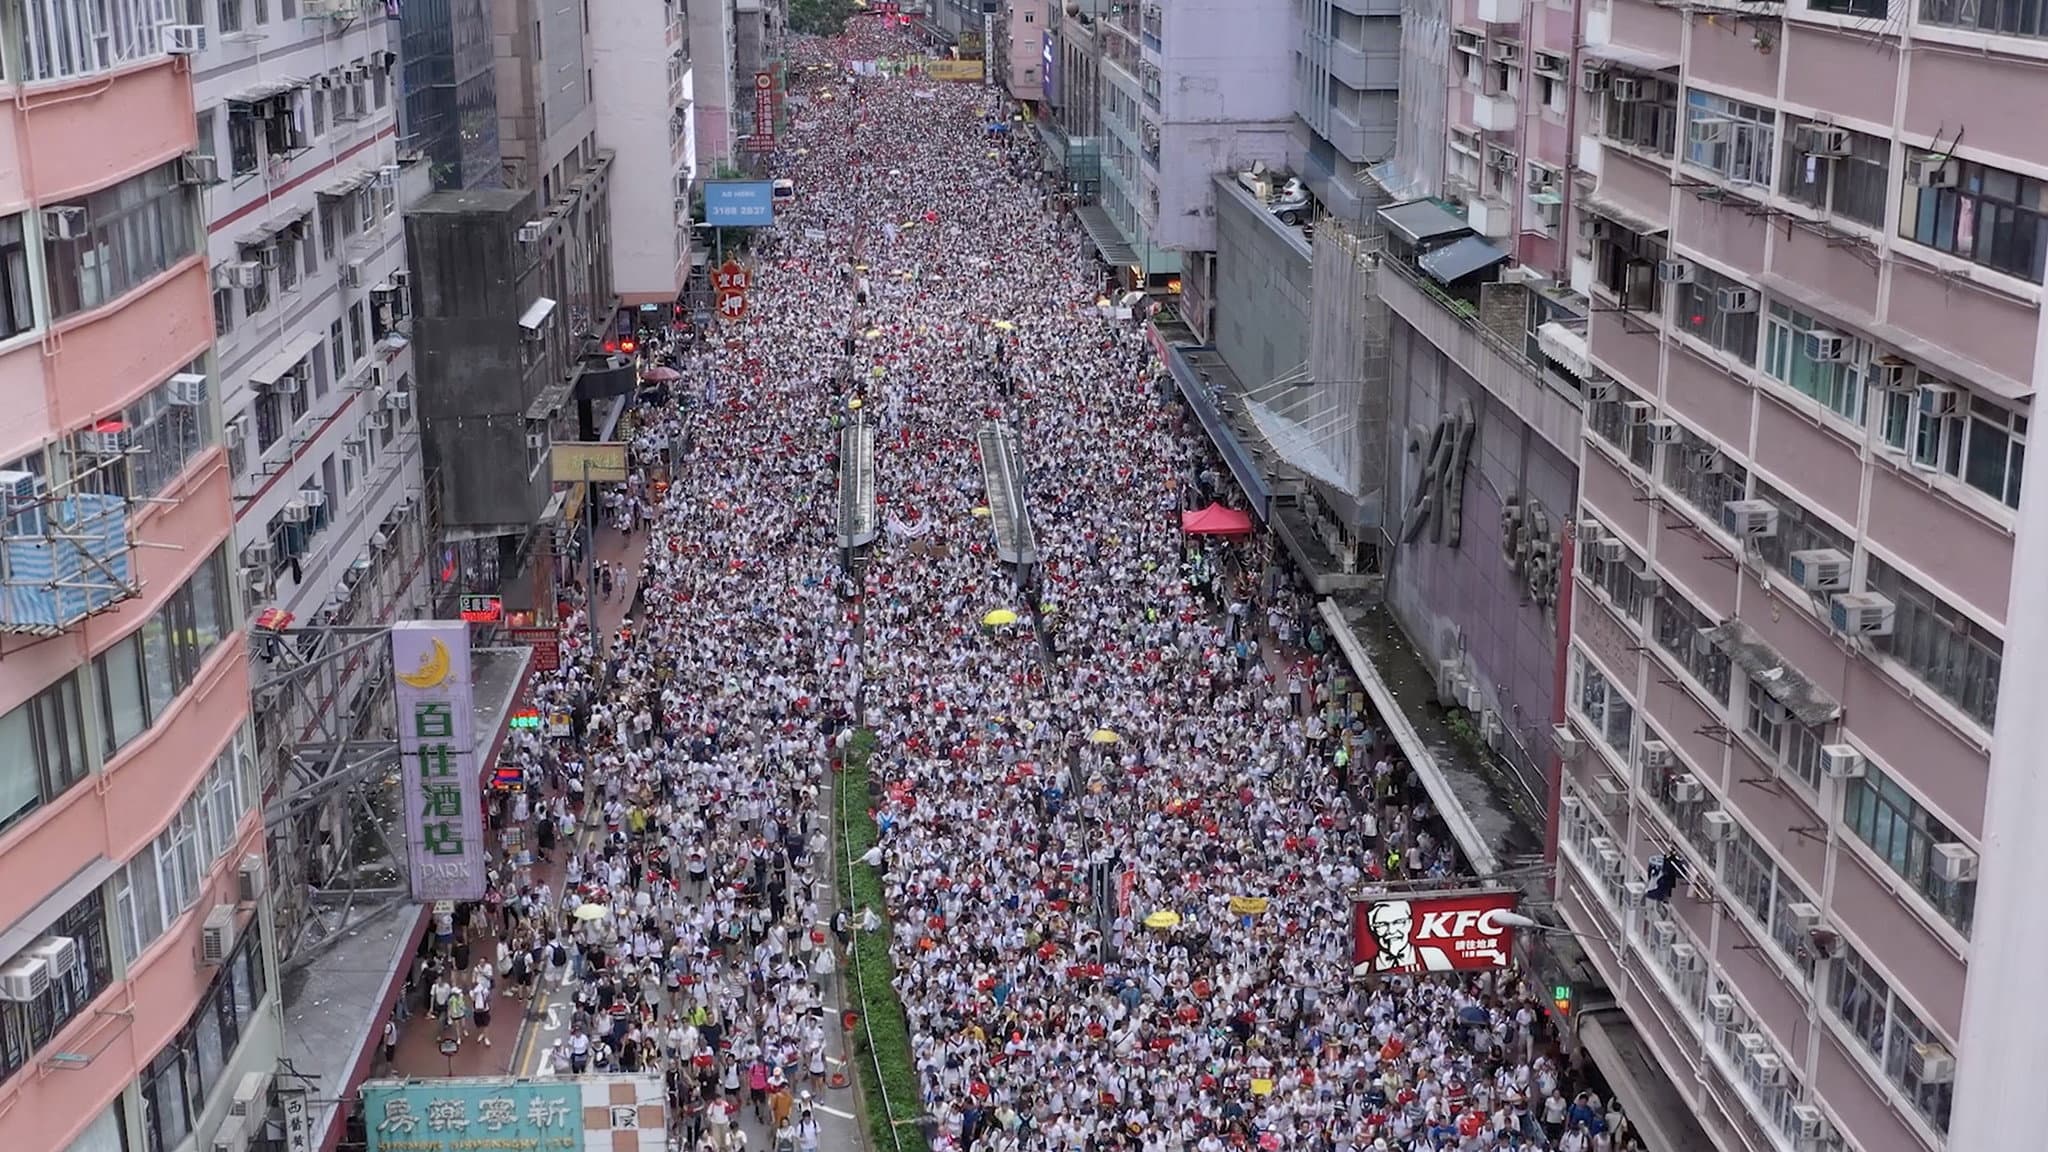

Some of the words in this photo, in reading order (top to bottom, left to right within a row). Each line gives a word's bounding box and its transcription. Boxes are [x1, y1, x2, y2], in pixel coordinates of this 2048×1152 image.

[721, 293, 743, 316] 押
[421, 862, 471, 879] PARK
[1416, 908, 1506, 940] KFC
